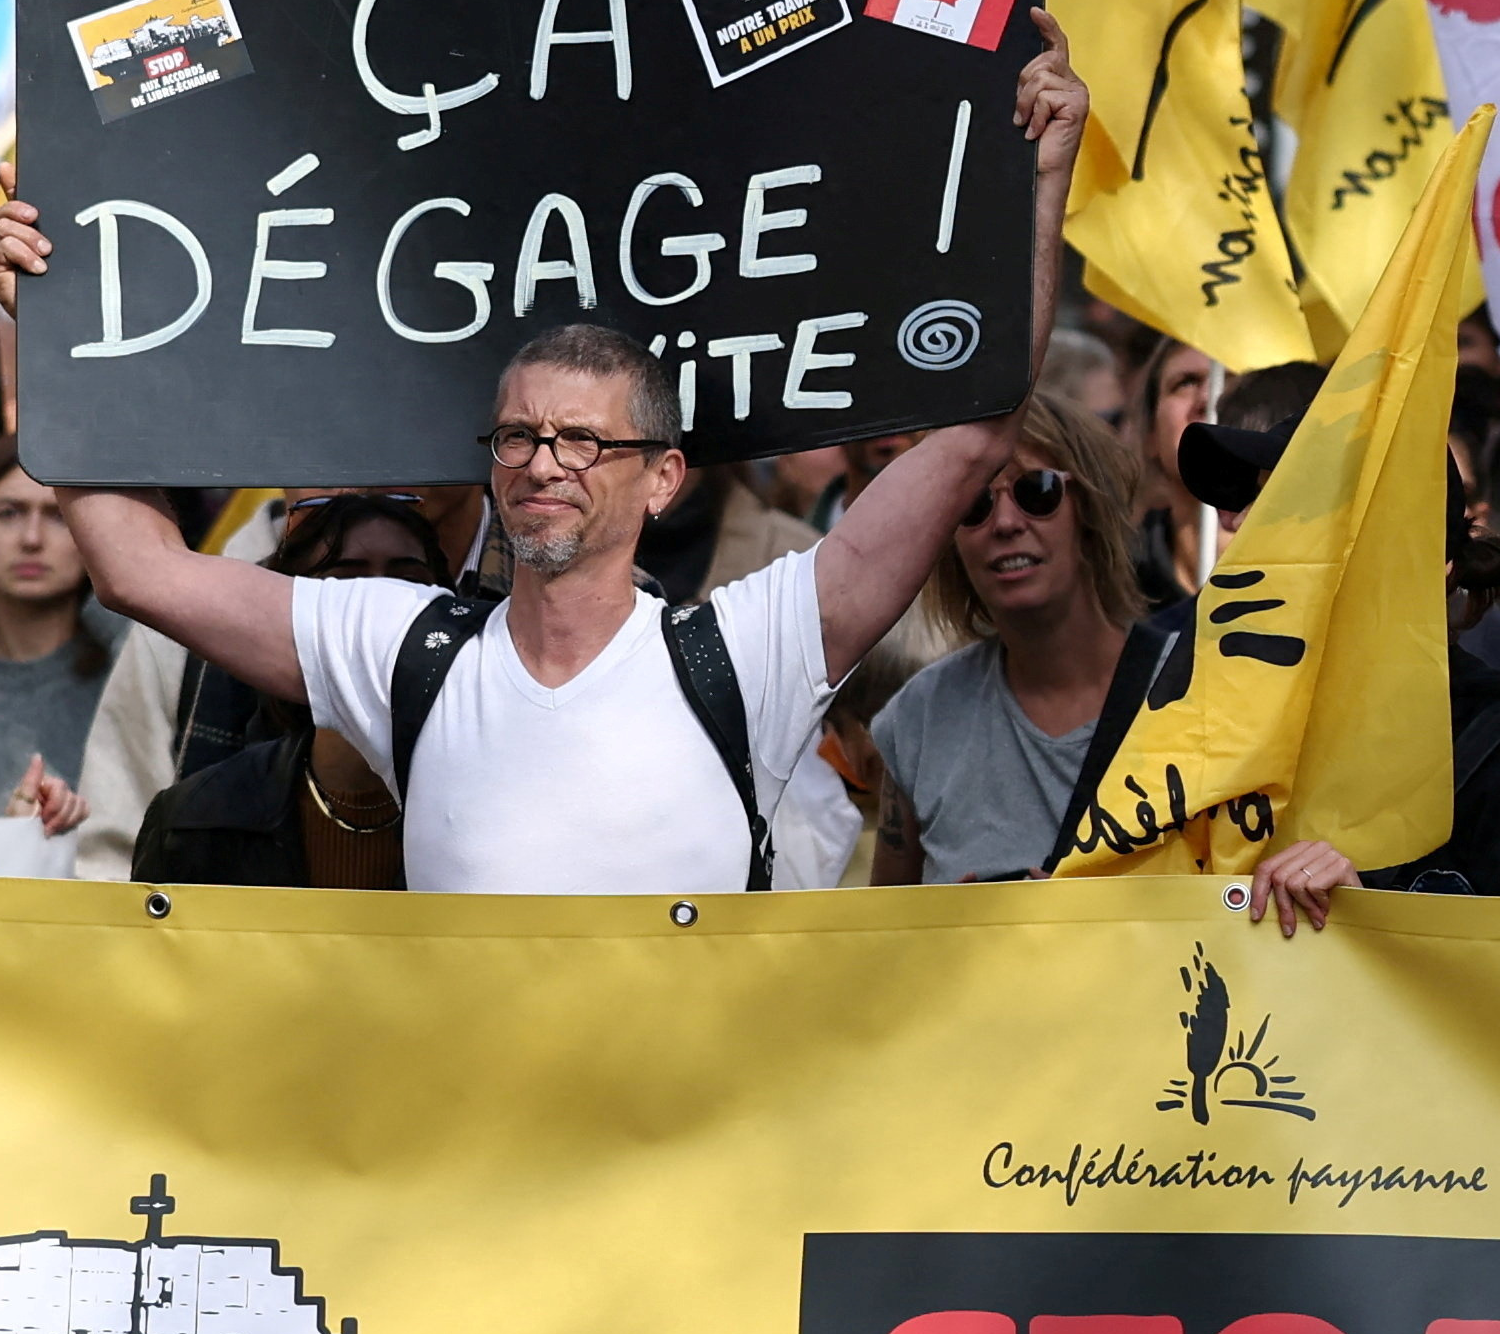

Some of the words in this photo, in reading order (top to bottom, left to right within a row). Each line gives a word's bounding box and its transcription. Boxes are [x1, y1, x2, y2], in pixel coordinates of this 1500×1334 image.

[716, 10, 766, 46] NOTRE
[739, 36, 753, 54] A
[753, 24, 777, 46] UN
[778, 5, 816, 36] PRIX
[140, 77, 161, 94] AUX
[162, 63, 205, 87] ACCORDS
[147, 51, 185, 76] STOP
[131, 94, 146, 108] DE
[146, 69, 221, 103] LIBRE-ÉCHANGE
[70, 152, 823, 361] DÉGAGE
[648, 310, 868, 432] iTE
[982, 1141, 1276, 1207] Confédération
[1287, 1157, 1489, 1209] paysanne
